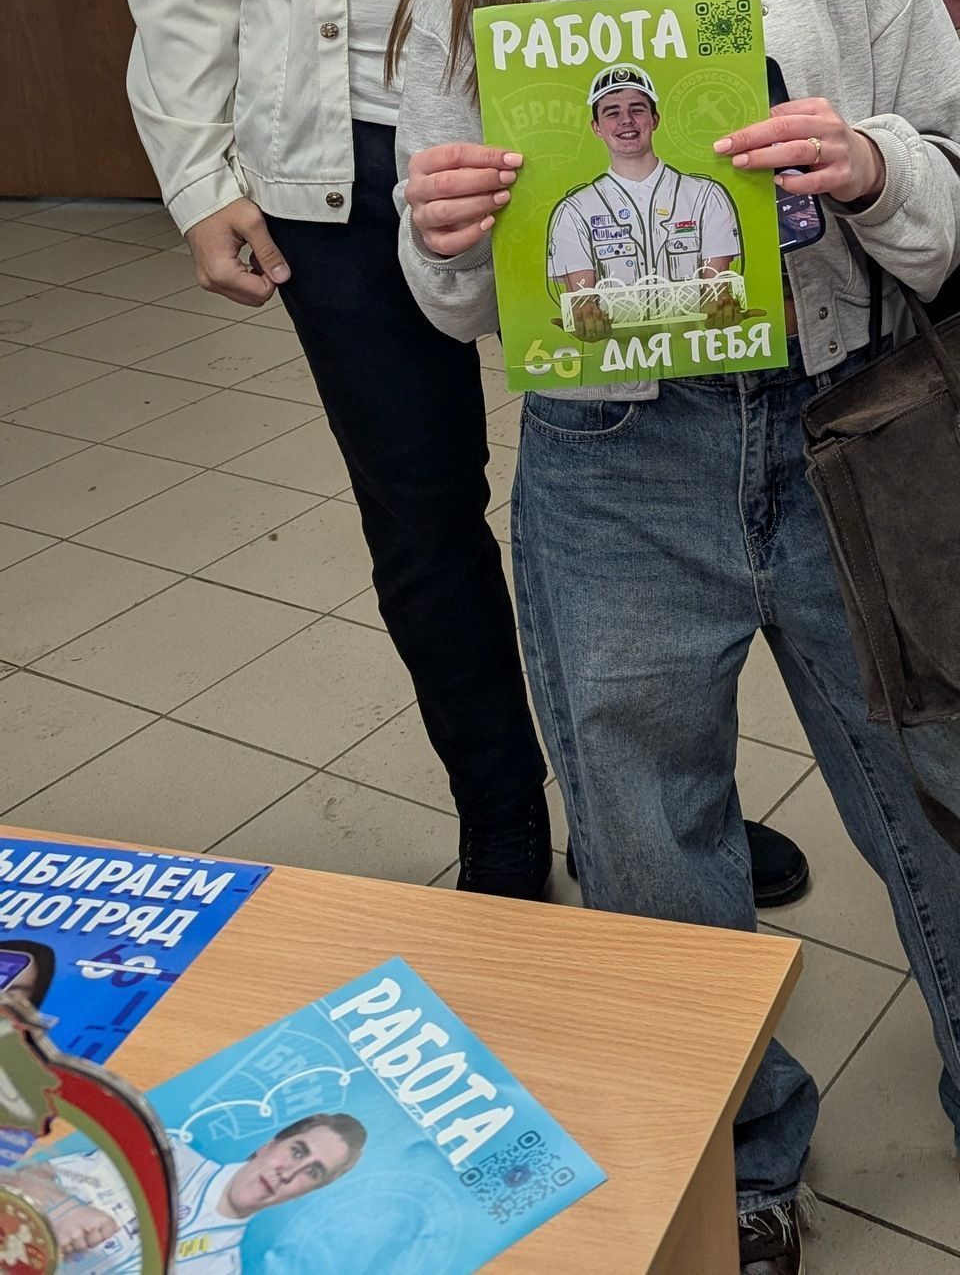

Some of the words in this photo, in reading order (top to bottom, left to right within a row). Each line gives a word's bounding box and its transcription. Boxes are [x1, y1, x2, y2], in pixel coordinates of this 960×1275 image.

[489, 9, 689, 70] РАБОТА
[510, 99, 584, 130] БРСМ
[600, 333, 672, 372] ДЛЯ
[683, 322, 772, 364] ТЕБЯ
[330, 977, 516, 1171] РАБОТА
